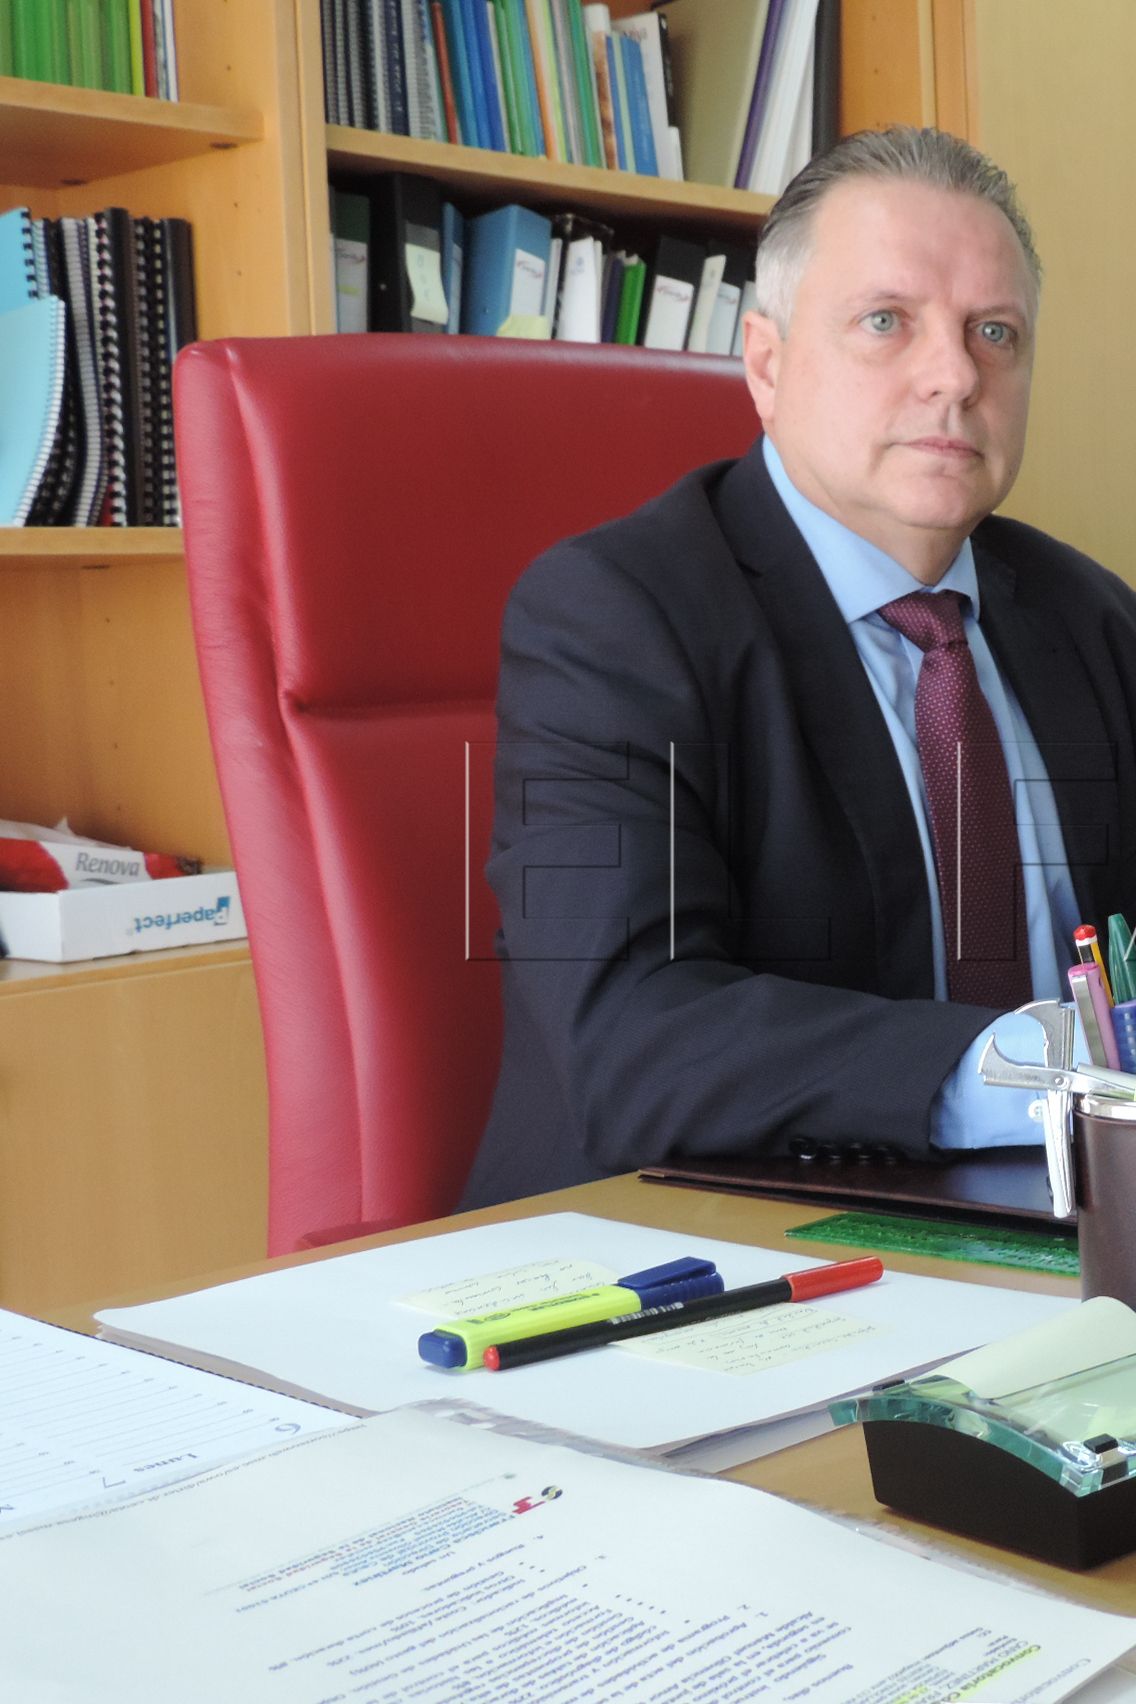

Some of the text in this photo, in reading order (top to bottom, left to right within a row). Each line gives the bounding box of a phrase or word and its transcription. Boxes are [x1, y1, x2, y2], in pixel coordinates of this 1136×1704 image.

[75, 852, 140, 877] Renova
[133, 1452, 199, 1473] Lunes
[733, 1632, 776, 1657] Manuel
[776, 1653, 803, 1669] para
[708, 1667, 732, 1681] sala
